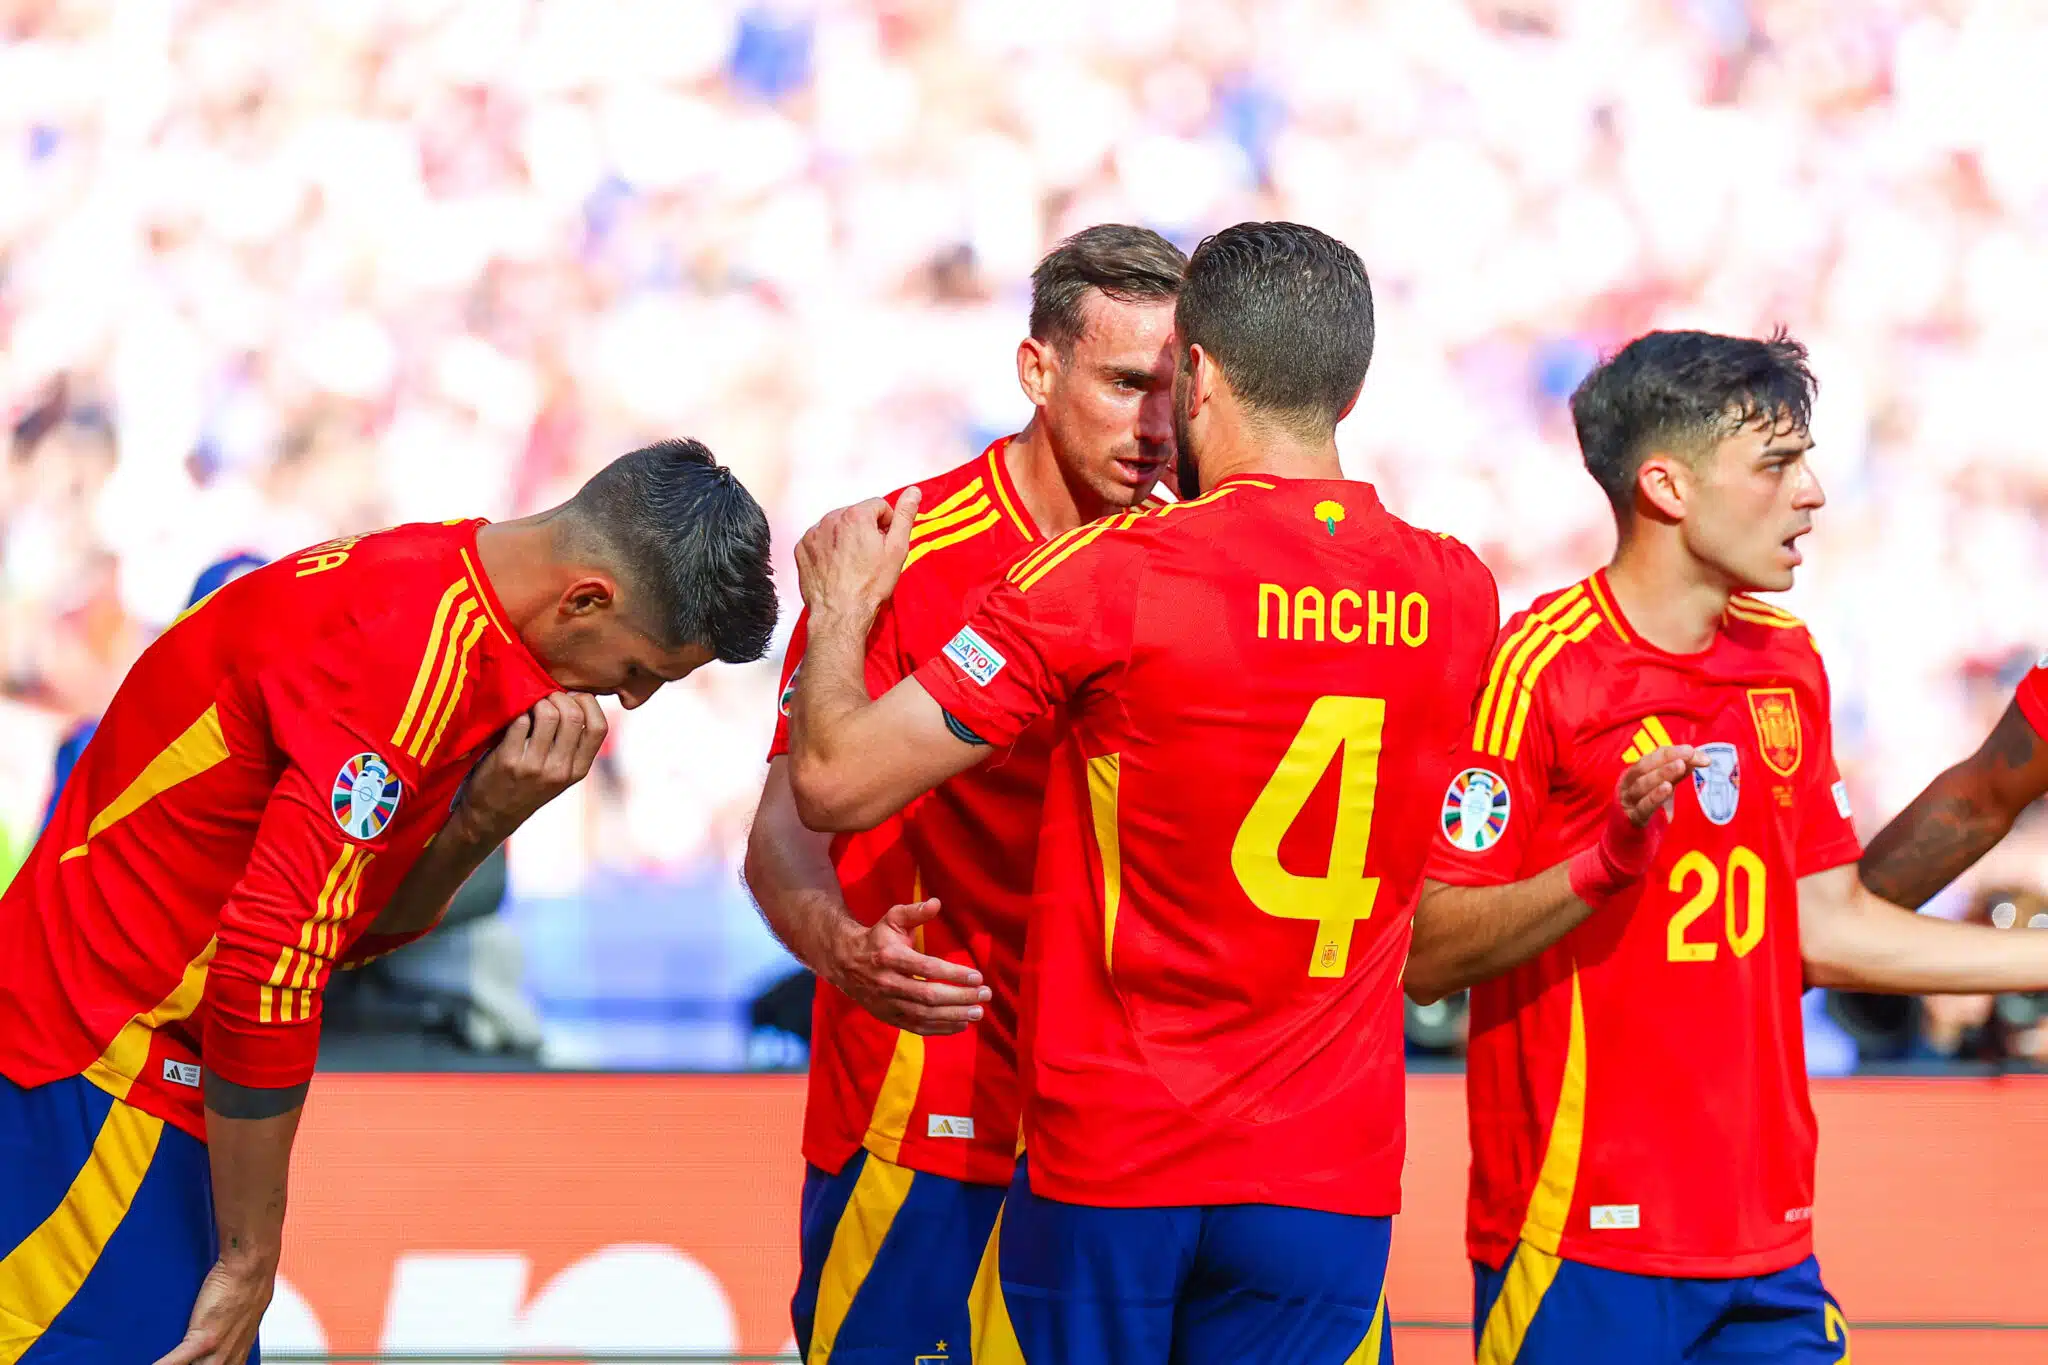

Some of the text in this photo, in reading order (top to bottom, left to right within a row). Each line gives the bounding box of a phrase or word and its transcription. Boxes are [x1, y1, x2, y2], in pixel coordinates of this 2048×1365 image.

[1257, 583, 1429, 647] NACHO
[1231, 695, 1386, 978] 4
[1666, 845, 1766, 962] 20
